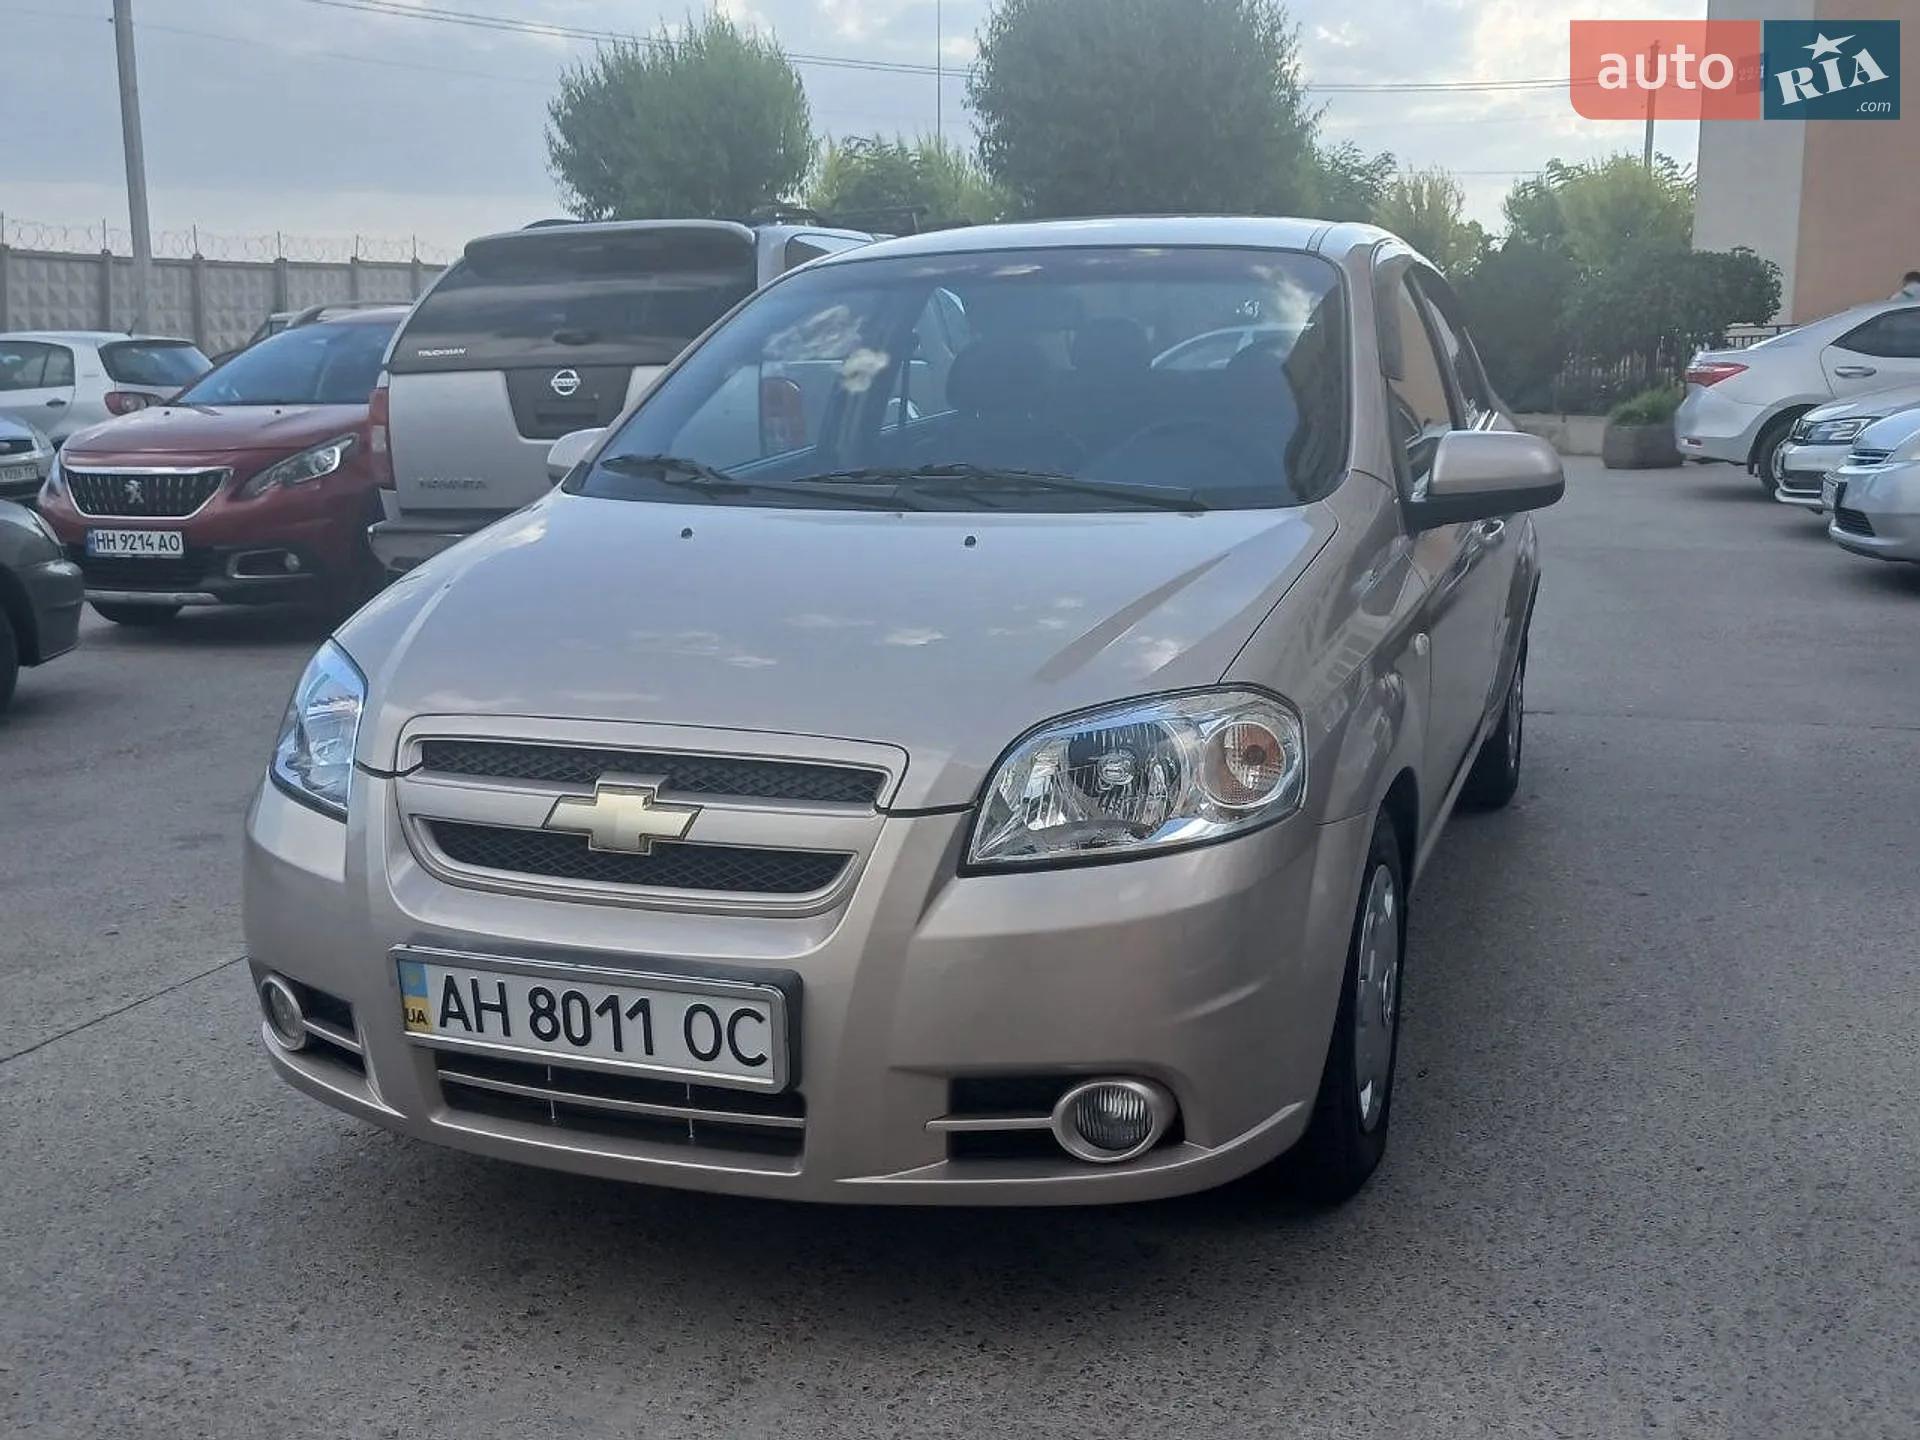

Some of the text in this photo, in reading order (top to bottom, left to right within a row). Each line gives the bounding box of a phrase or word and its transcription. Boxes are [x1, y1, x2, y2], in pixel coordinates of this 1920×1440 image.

[96, 533, 180, 551] HH 9214 AO
[406, 1008, 428, 1025] UA
[439, 974, 768, 1067] AH 8011 OC
